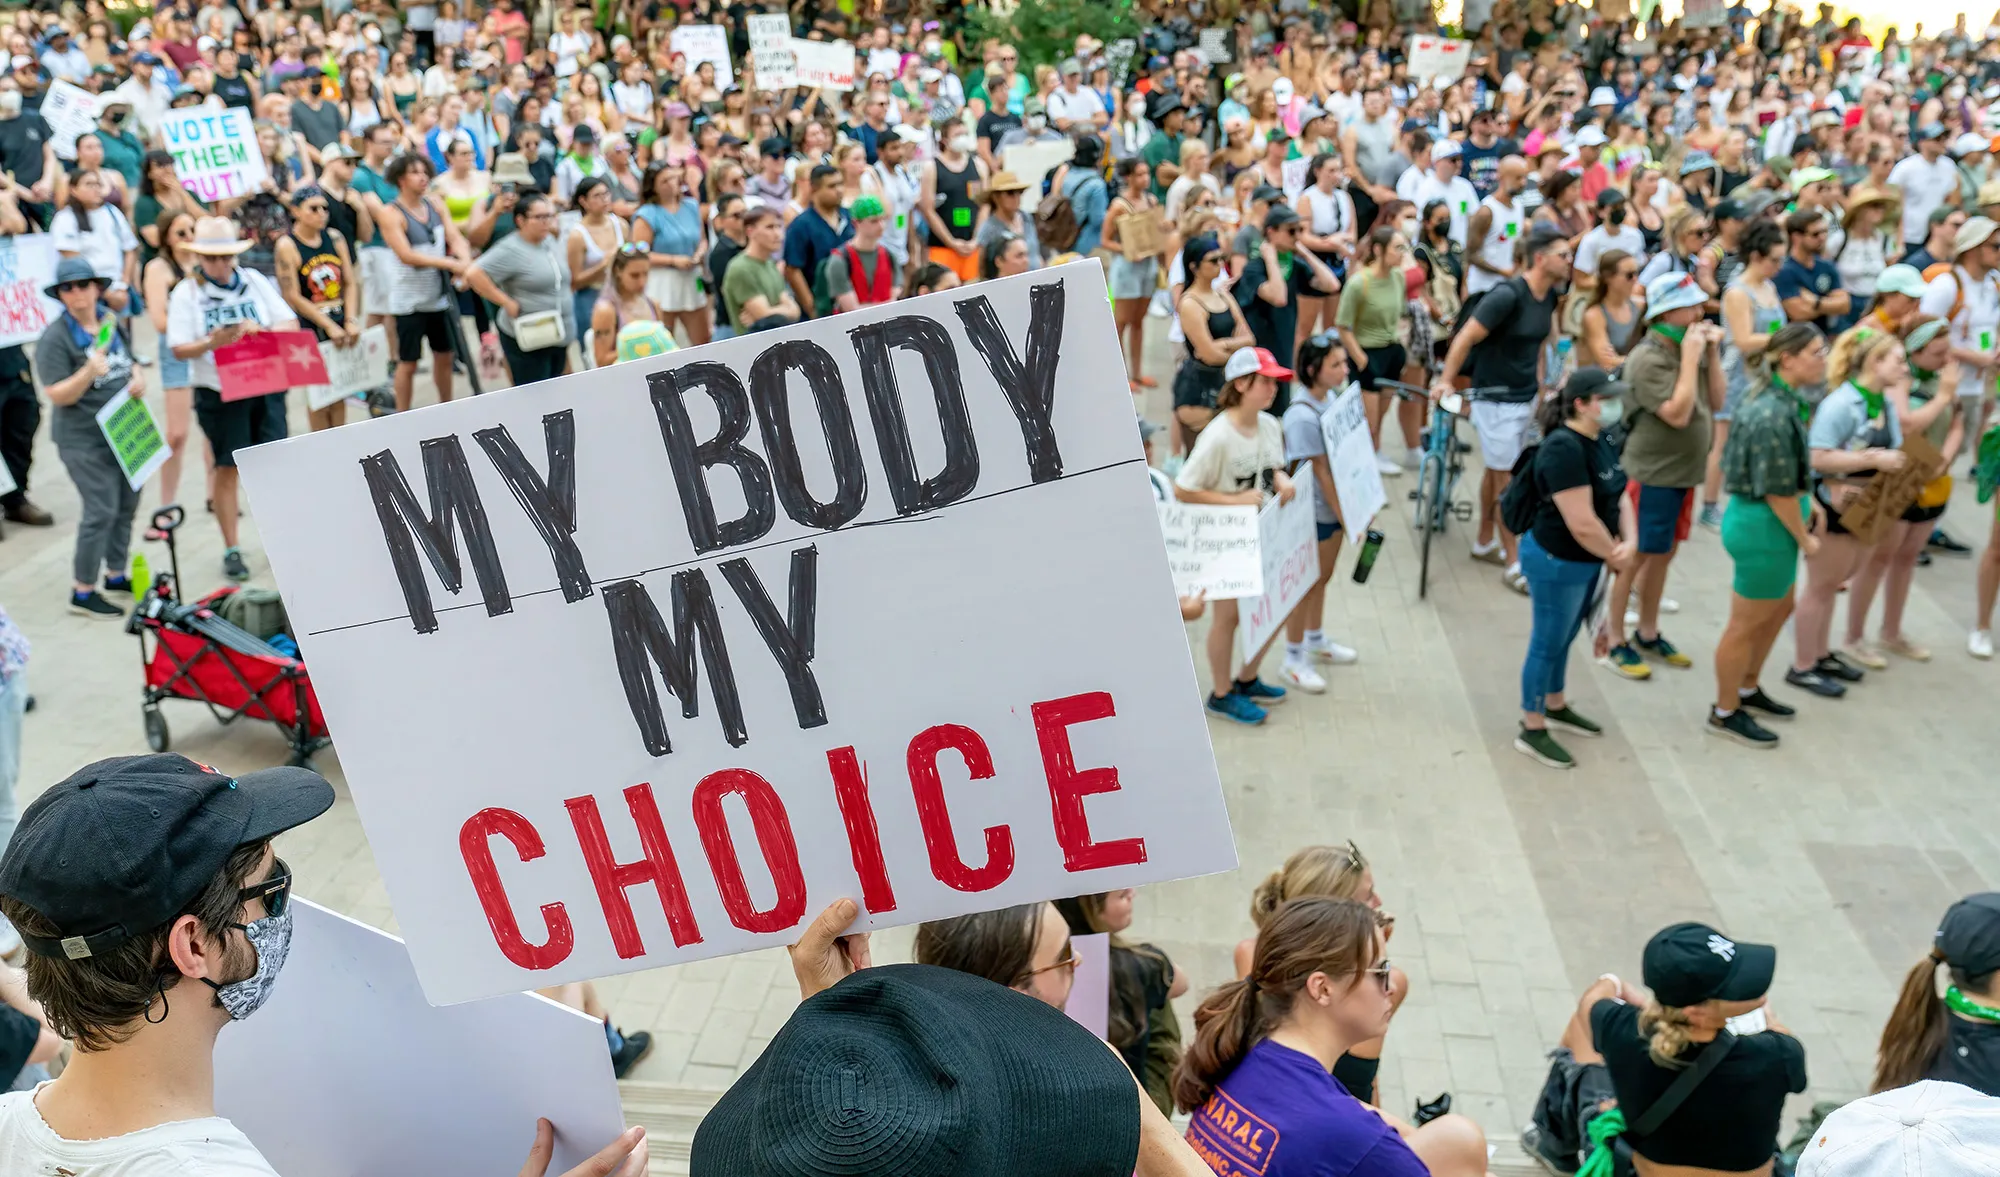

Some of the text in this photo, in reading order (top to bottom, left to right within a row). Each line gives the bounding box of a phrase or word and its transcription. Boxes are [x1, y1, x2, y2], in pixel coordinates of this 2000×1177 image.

[164, 115, 240, 143] VOTE
[172, 142, 249, 172] THEM
[358, 277, 1066, 634] MY BODY
[600, 541, 829, 758] MY
[459, 691, 1148, 971] CHOICE
[1706, 934, 1736, 962] NY
[1202, 1094, 1264, 1153] NARAL
